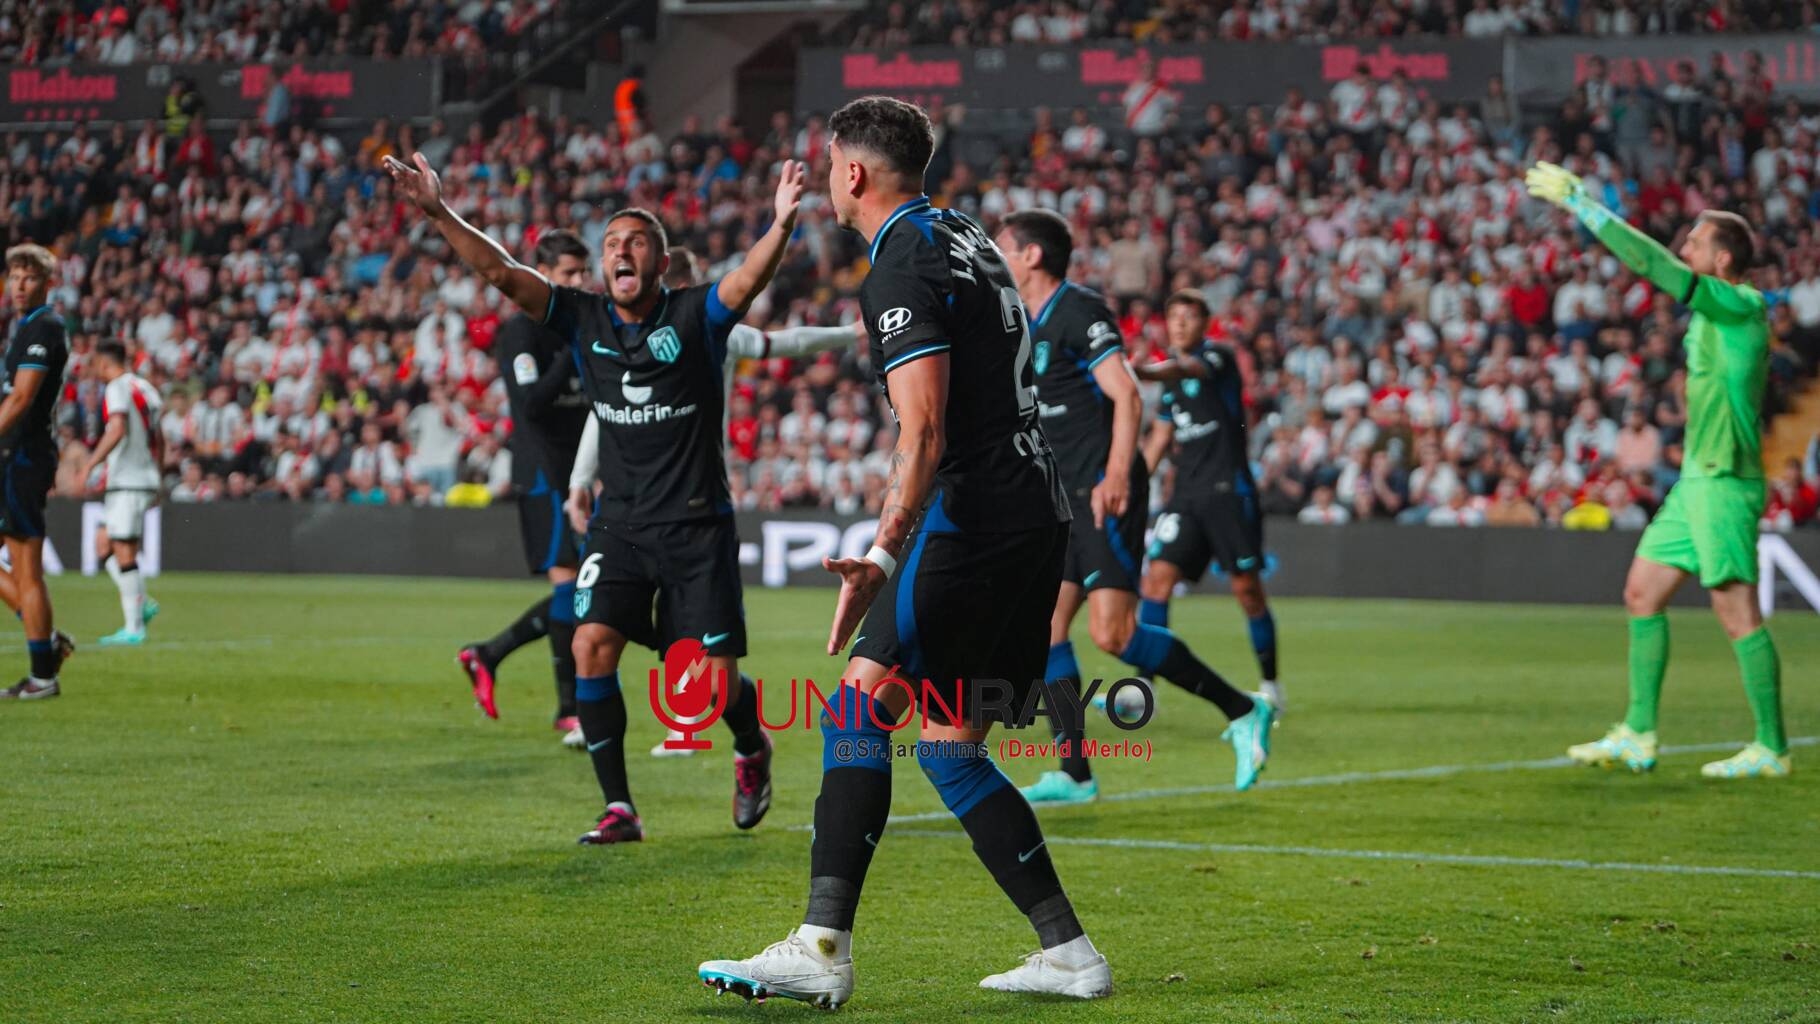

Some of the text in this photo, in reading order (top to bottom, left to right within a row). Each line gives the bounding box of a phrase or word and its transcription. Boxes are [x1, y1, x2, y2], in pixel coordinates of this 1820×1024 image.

[241, 63, 354, 98] Mhou
[1000, 286, 1038, 416] 2
[576, 552, 605, 589] 6
